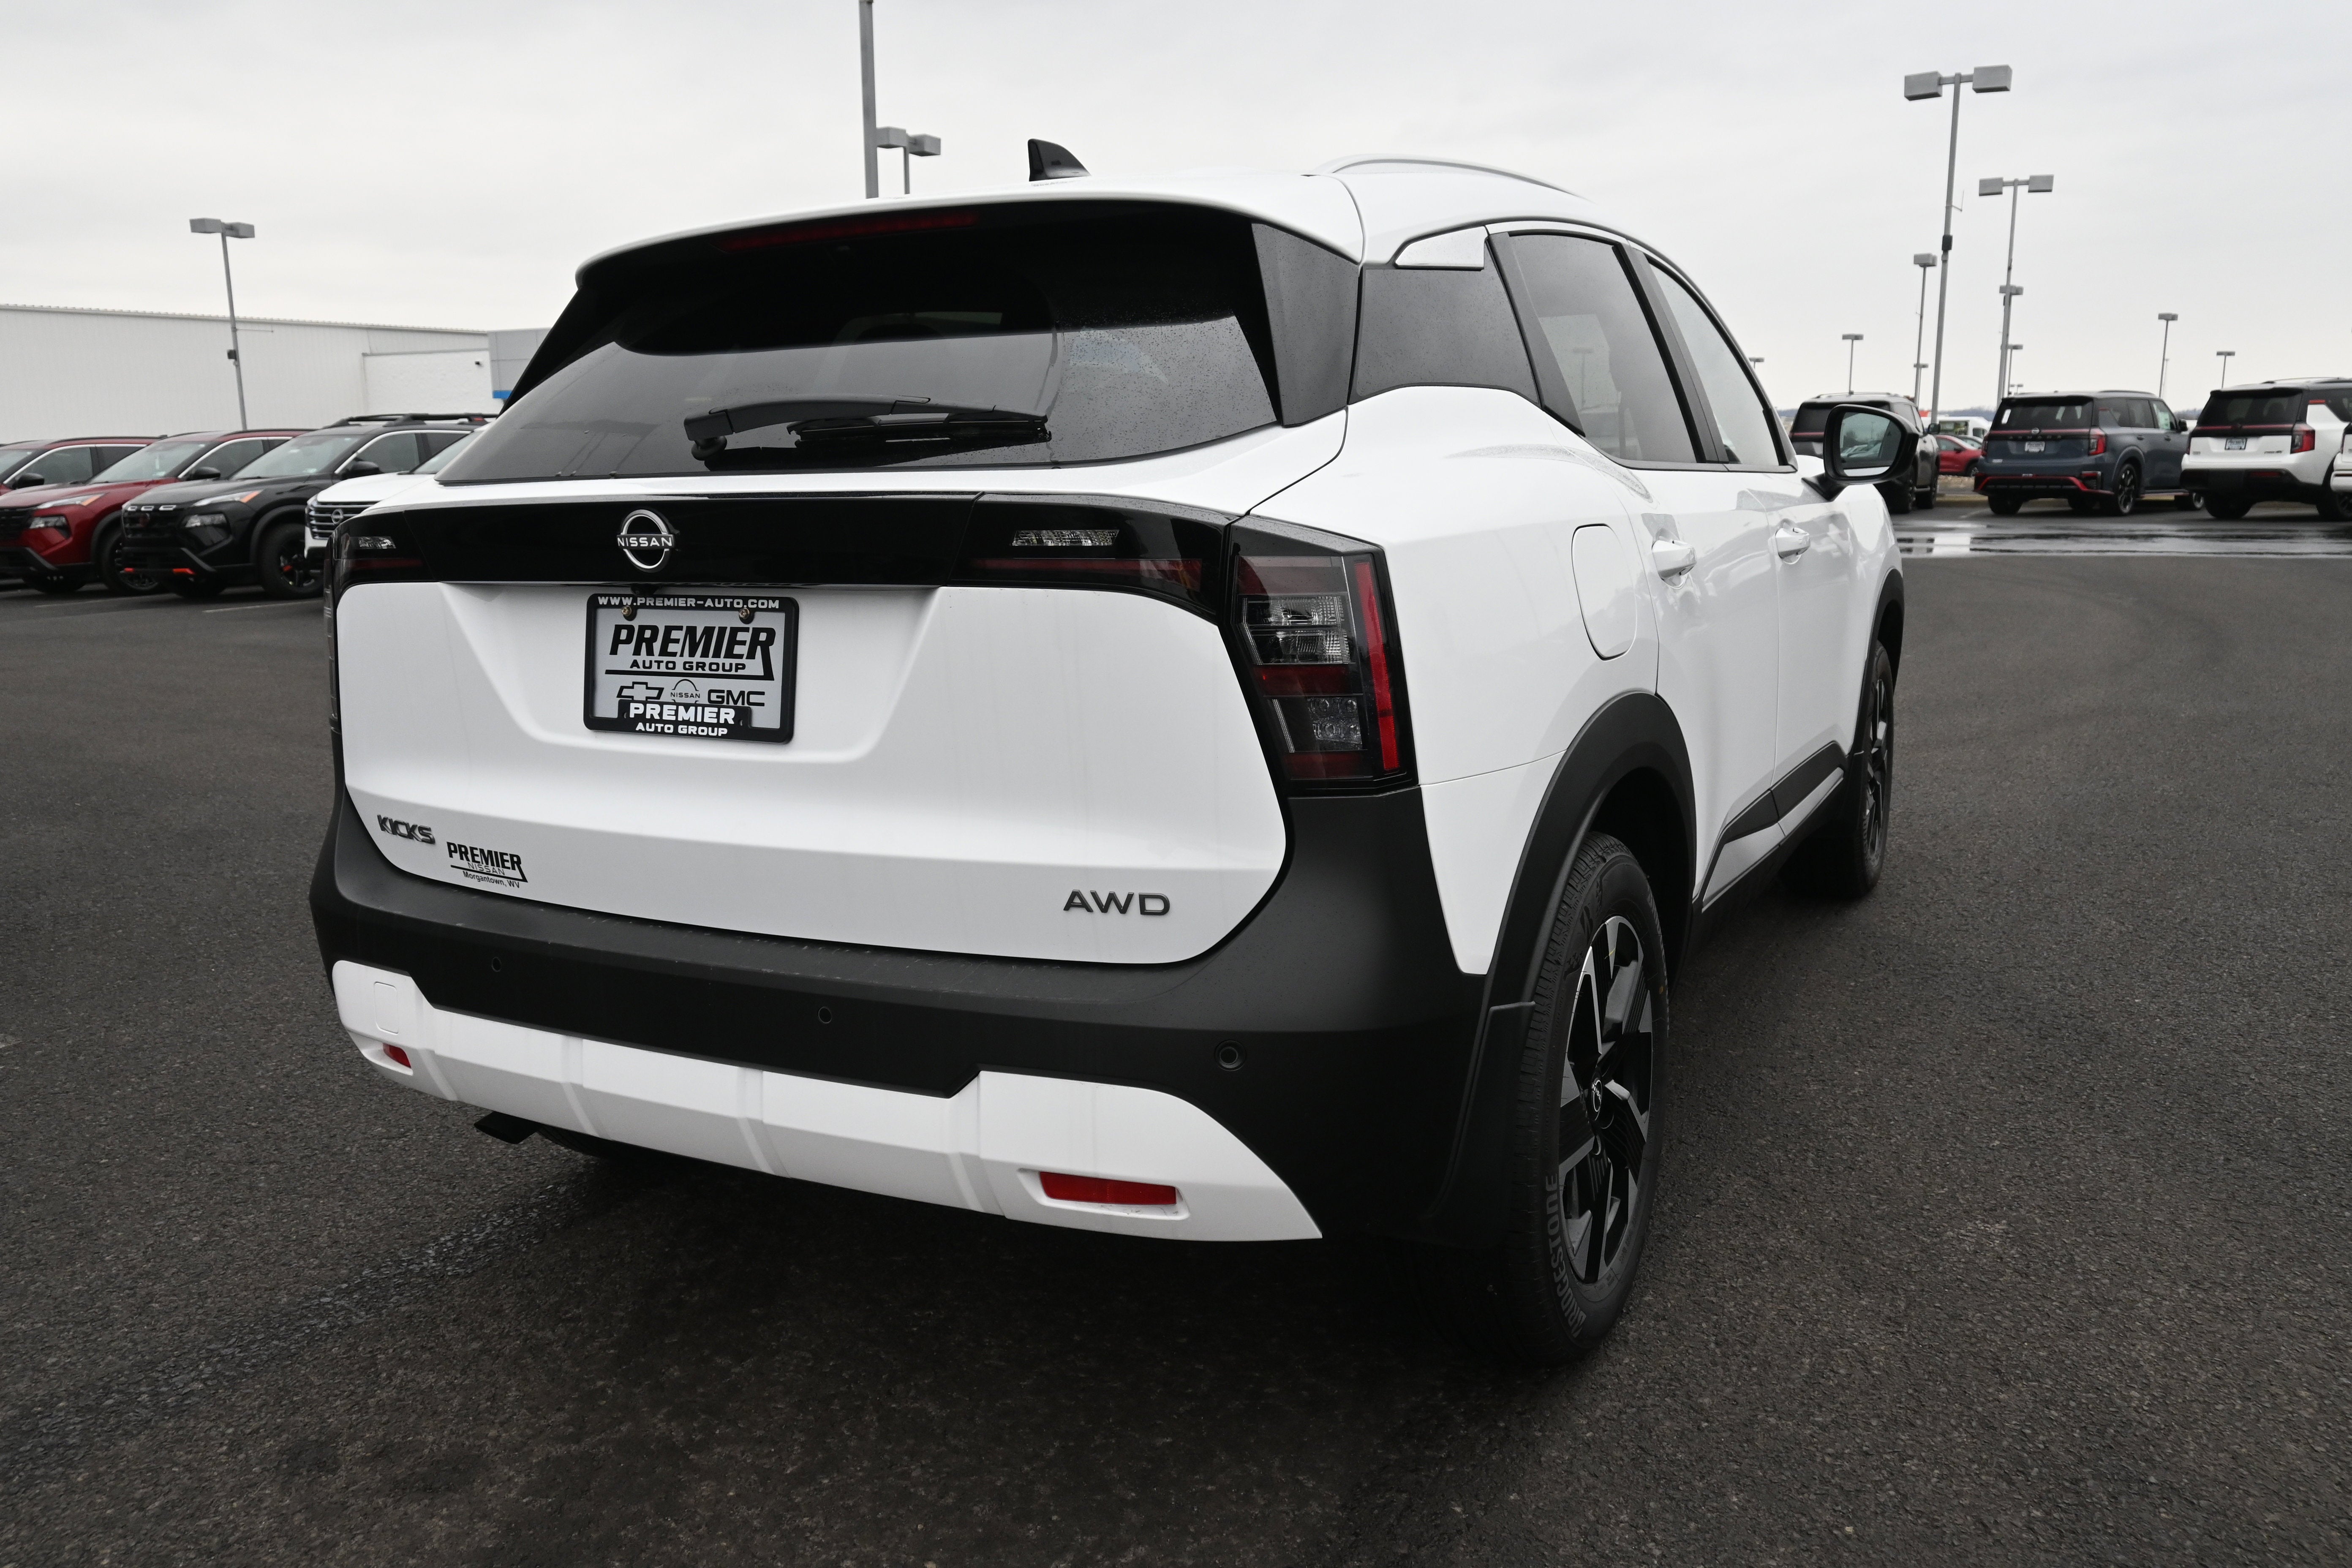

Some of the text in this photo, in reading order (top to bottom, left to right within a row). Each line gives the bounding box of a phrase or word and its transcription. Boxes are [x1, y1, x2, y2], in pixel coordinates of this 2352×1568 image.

[617, 537, 672, 547] NISSAN
[598, 596, 779, 609] WWW.PREMIER-AUTO.COM
[609, 624, 776, 681] PREMIER
[629, 659, 746, 673] AUTO GROUP
[670, 691, 701, 700] NISSAN
[707, 689, 765, 707] GMC
[629, 702, 735, 725] PREMIER
[635, 722, 728, 737] AUTO GROUP
[377, 814, 436, 844] KICKS
[446, 841, 528, 883] PREMIER
[468, 862, 505, 876] NISSAN
[463, 871, 520, 888] Morgantown, WV
[1063, 889, 1171, 915] AWD
[1546, 1173, 1587, 1338] BRIDGESTONE
